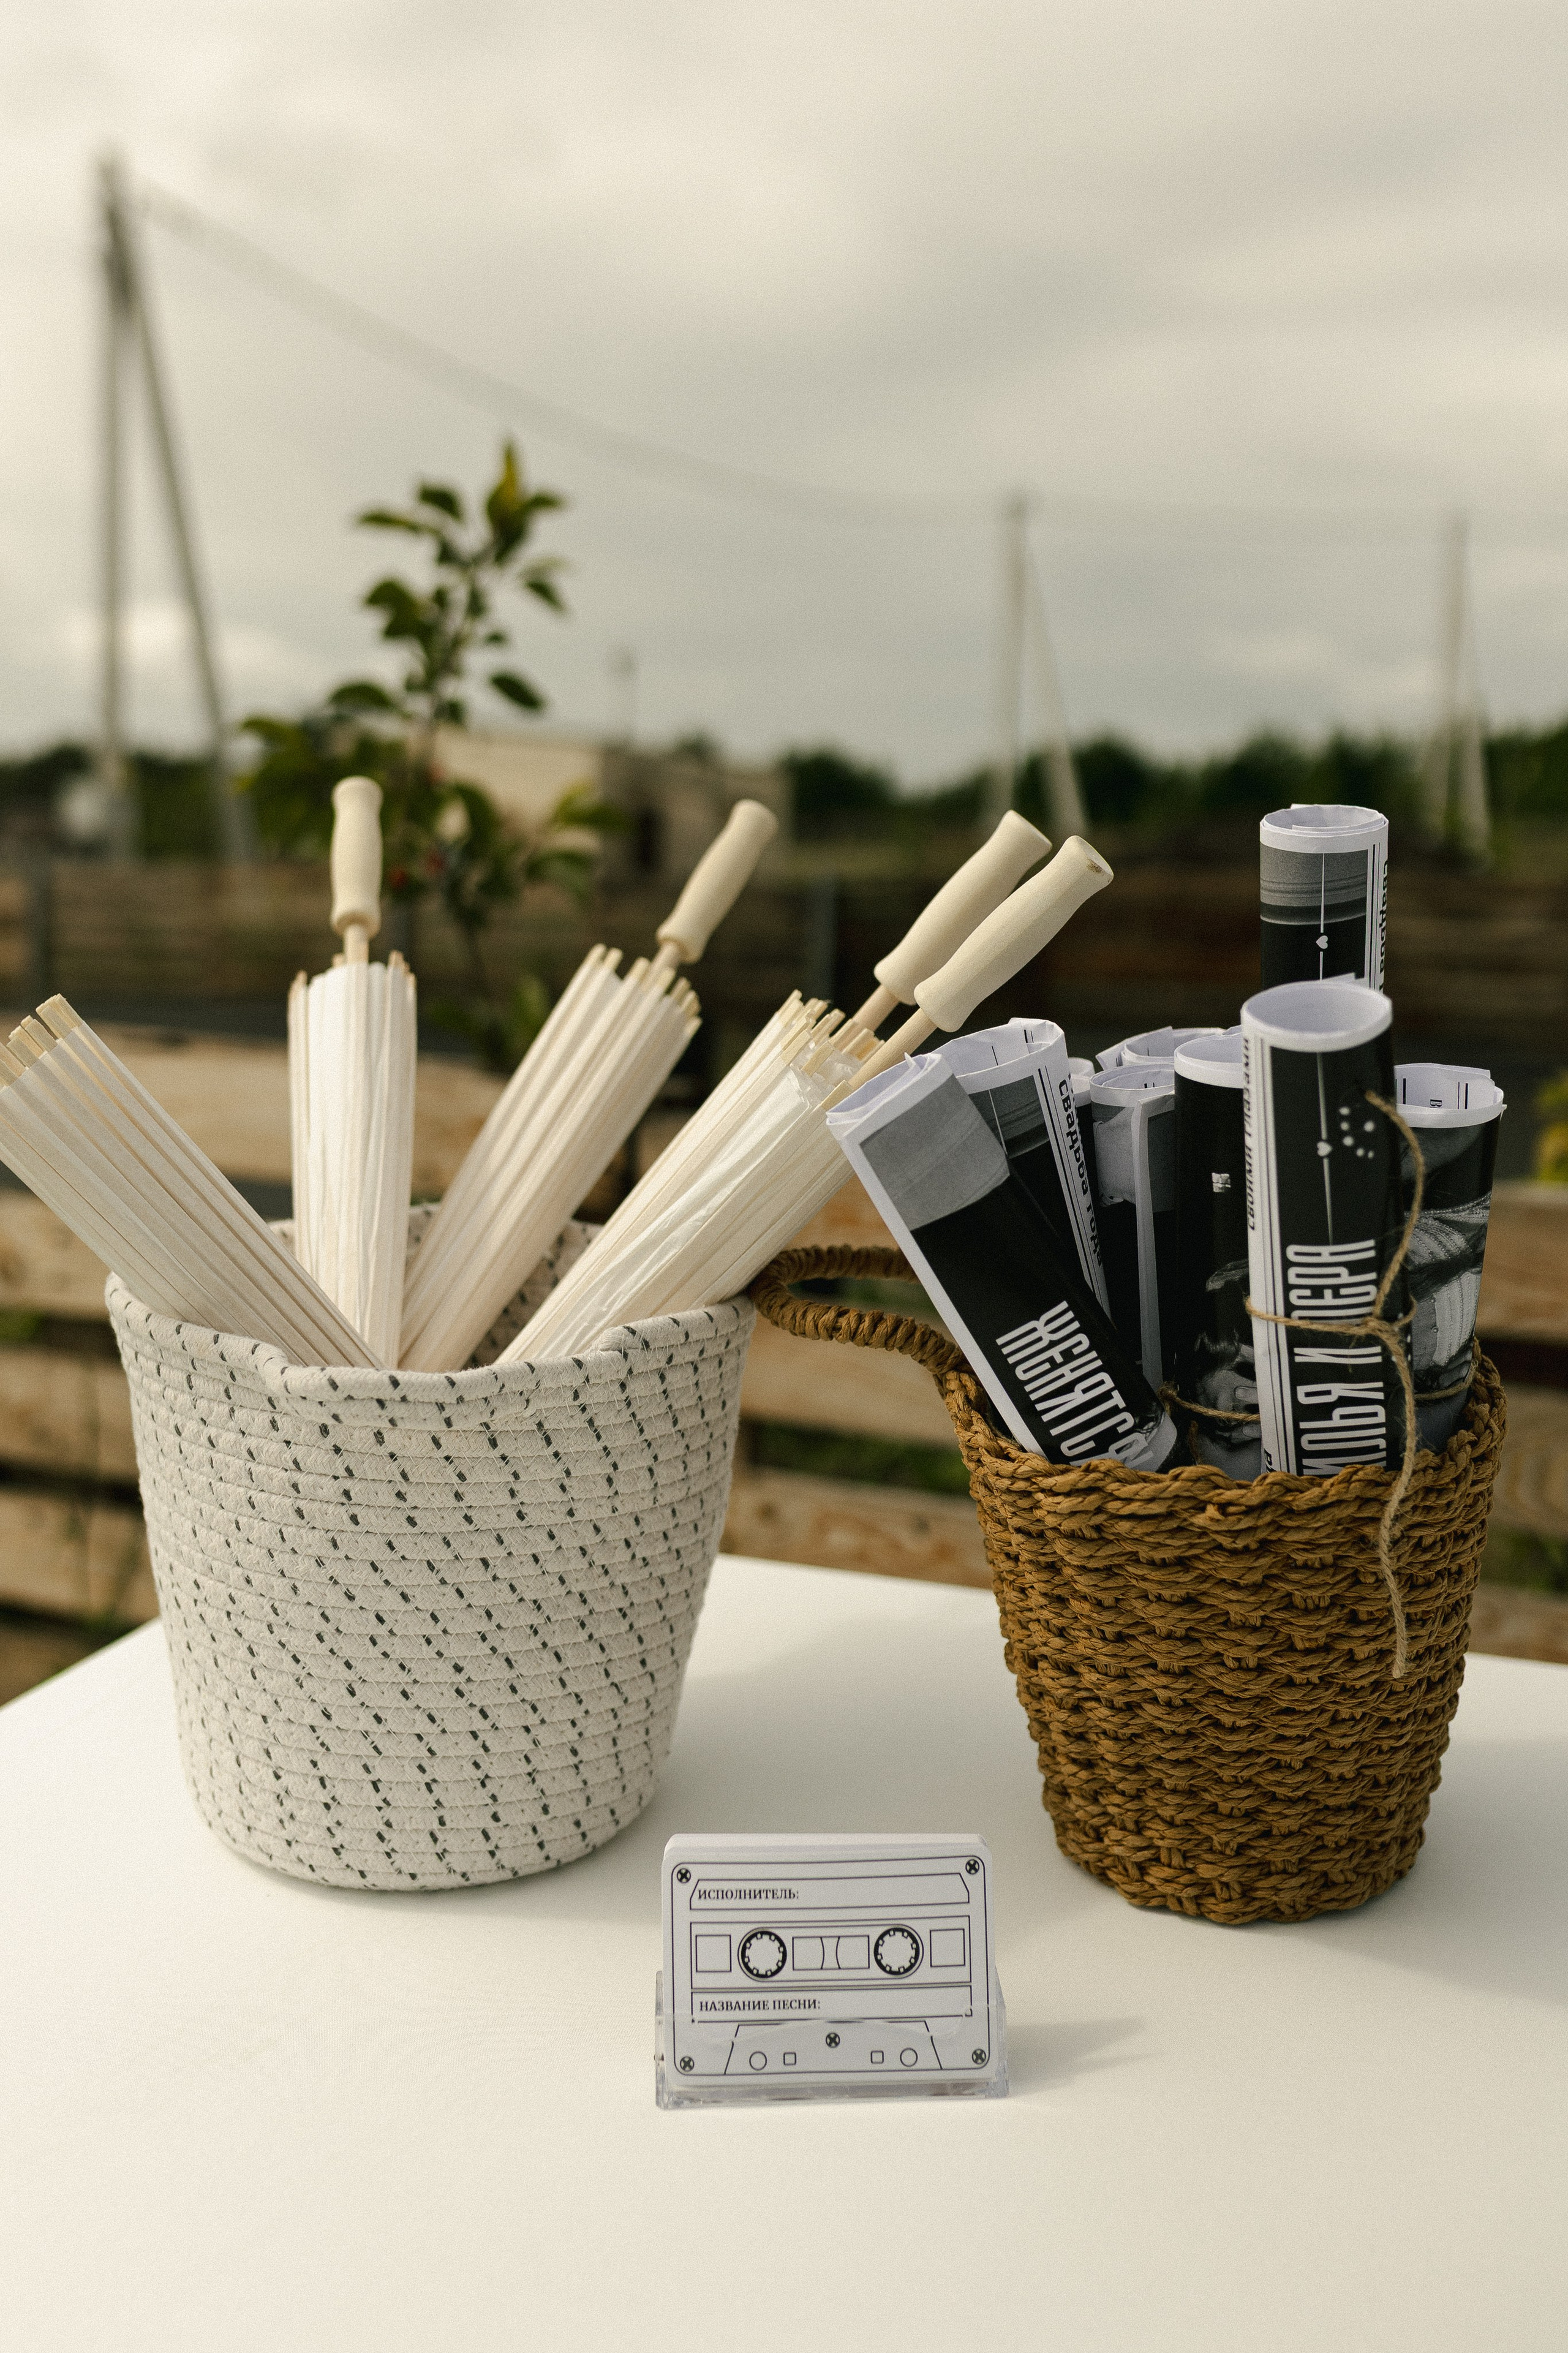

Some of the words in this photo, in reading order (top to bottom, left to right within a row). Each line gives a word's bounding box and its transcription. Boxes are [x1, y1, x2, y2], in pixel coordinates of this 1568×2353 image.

[1058, 1079, 1089, 1196] свадьба
[1286, 1238, 1378, 1326] ЛЕРА
[1293, 1345, 1383, 1365] И
[1296, 1381, 1387, 1476] ИЛЬЯ
[698, 1889, 799, 1900] ИСПОЛНИТЕЛЬ:
[699, 2000, 769, 2012] НАЗВАНИЕ
[772, 1999, 820, 2011] ПЕСНИ:
